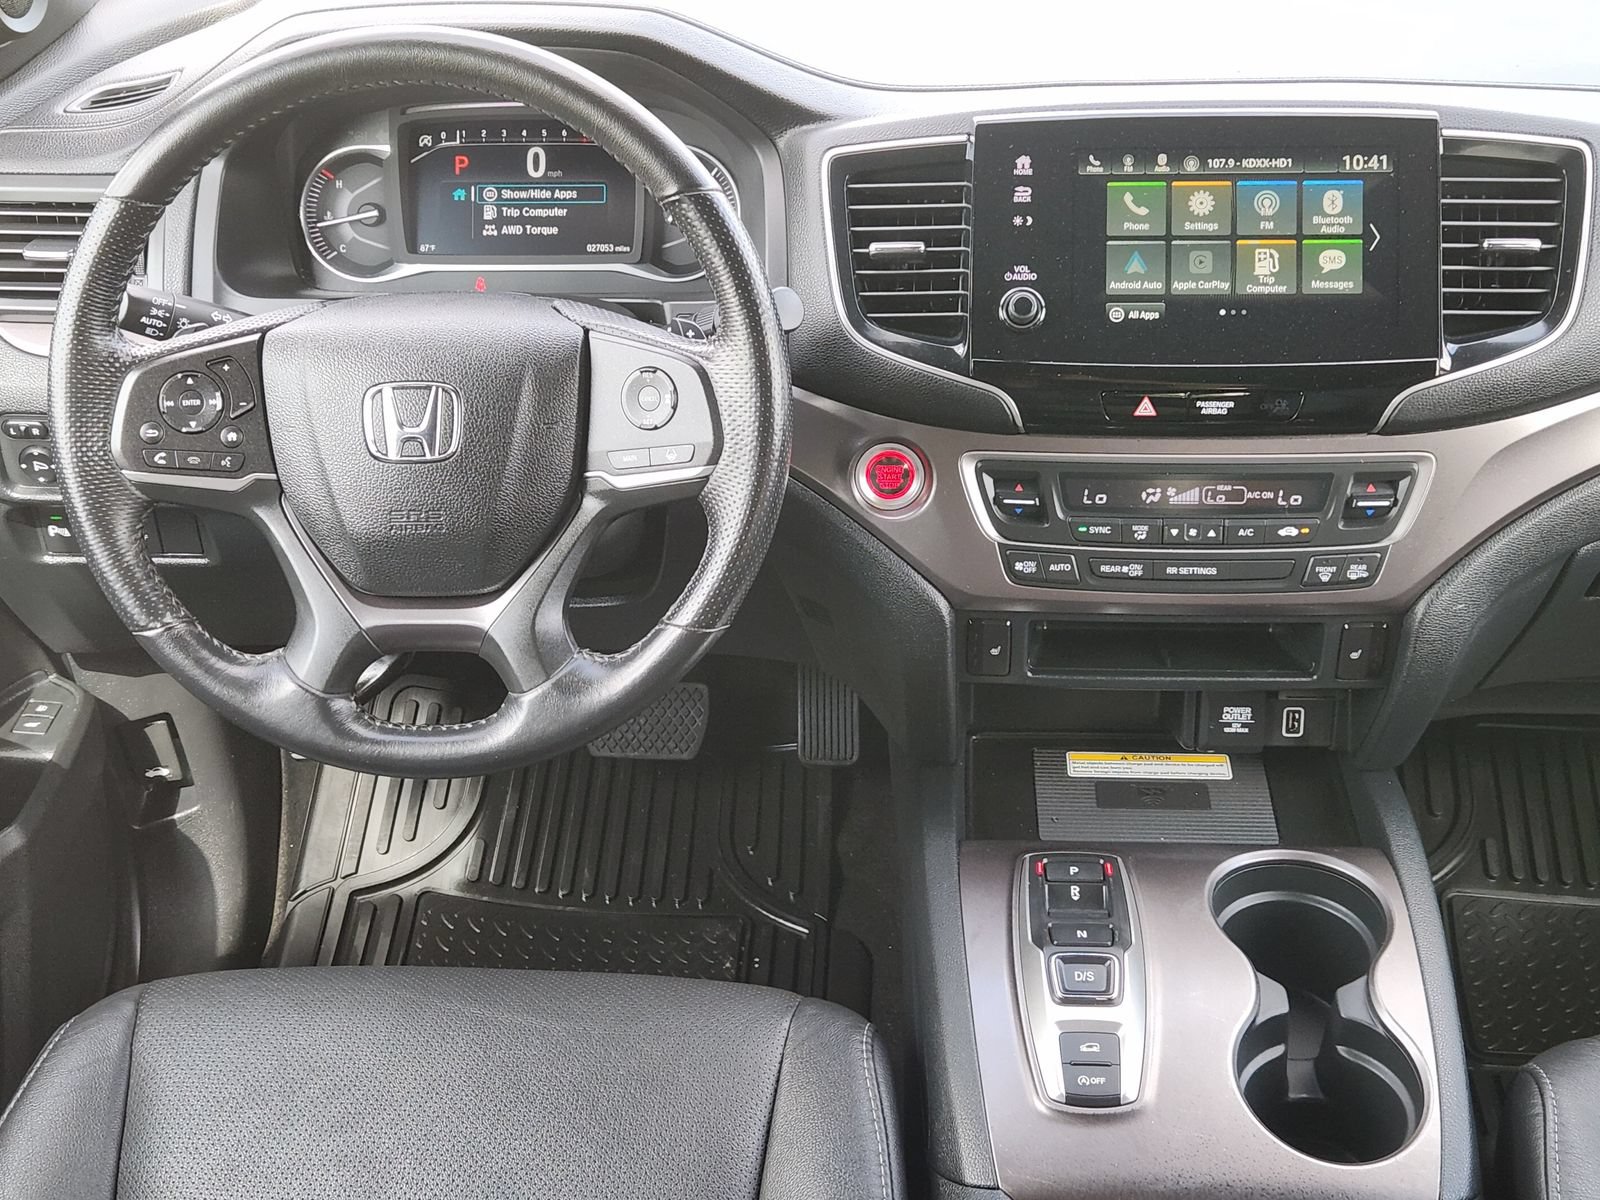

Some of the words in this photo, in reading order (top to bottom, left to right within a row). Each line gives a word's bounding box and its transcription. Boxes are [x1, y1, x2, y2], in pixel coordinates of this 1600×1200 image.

[454, 155, 469, 176] P
[526, 146, 546, 178] 0
[547, 170, 563, 178] mph
[1207, 158, 1235, 169] 107.9
[1343, 154, 1388, 171] 10:41
[1013, 168, 1033, 176] HOME
[336, 180, 343, 189] H
[501, 189, 551, 199] Show/Hide
[554, 189, 578, 200] Apps
[1013, 195, 1032, 203] BACK
[501, 207, 520, 218] Trip
[522, 207, 568, 218] Computer
[1312, 216, 1353, 224] Bluetooth
[1123, 222, 1150, 231] Phone
[1184, 222, 1219, 232] Settings
[1260, 221, 1274, 230] FM
[1320, 225, 1346, 233] Audio
[501, 225, 523, 235] AWD
[525, 225, 559, 236] Torque
[340, 244, 347, 253] C
[586, 244, 614, 252] 027053
[1322, 255, 1343, 265] SMS
[1013, 265, 1031, 273] VOL
[1012, 272, 1038, 281] AUDIO
[1258, 275, 1275, 284] Trip
[1109, 280, 1141, 289] Android
[1142, 281, 1162, 289] Auto
[1172, 281, 1197, 290] Apple
[1198, 280, 1230, 290] CarPlay
[1246, 284, 1287, 294] Computer
[1311, 280, 1354, 290] Messages
[1128, 310, 1139, 319] All
[1140, 310, 1160, 320] Apps
[140, 316, 163, 328] AUTO
[182, 399, 201, 407] ENTER
[1200, 407, 1228, 415] AIRBAG
[31, 428, 40, 436] R
[1083, 488, 1108, 504] Lo
[1247, 491, 1260, 499] A/C
[1261, 491, 1274, 499] ON
[1277, 489, 1303, 505] Lo
[1088, 526, 1112, 534] SYNC
[1238, 528, 1255, 537] A/C
[1049, 563, 1072, 571] AUTO
[1100, 564, 1121, 573] REAR
[1178, 567, 1217, 575] SETTINGS
[1223, 706, 1252, 714] POWER
[1069, 866, 1079, 875] P
[1070, 885, 1080, 897] R
[1076, 929, 1088, 938] N
[1074, 971, 1095, 981] D/S
[1090, 1076, 1106, 1085] OFF
